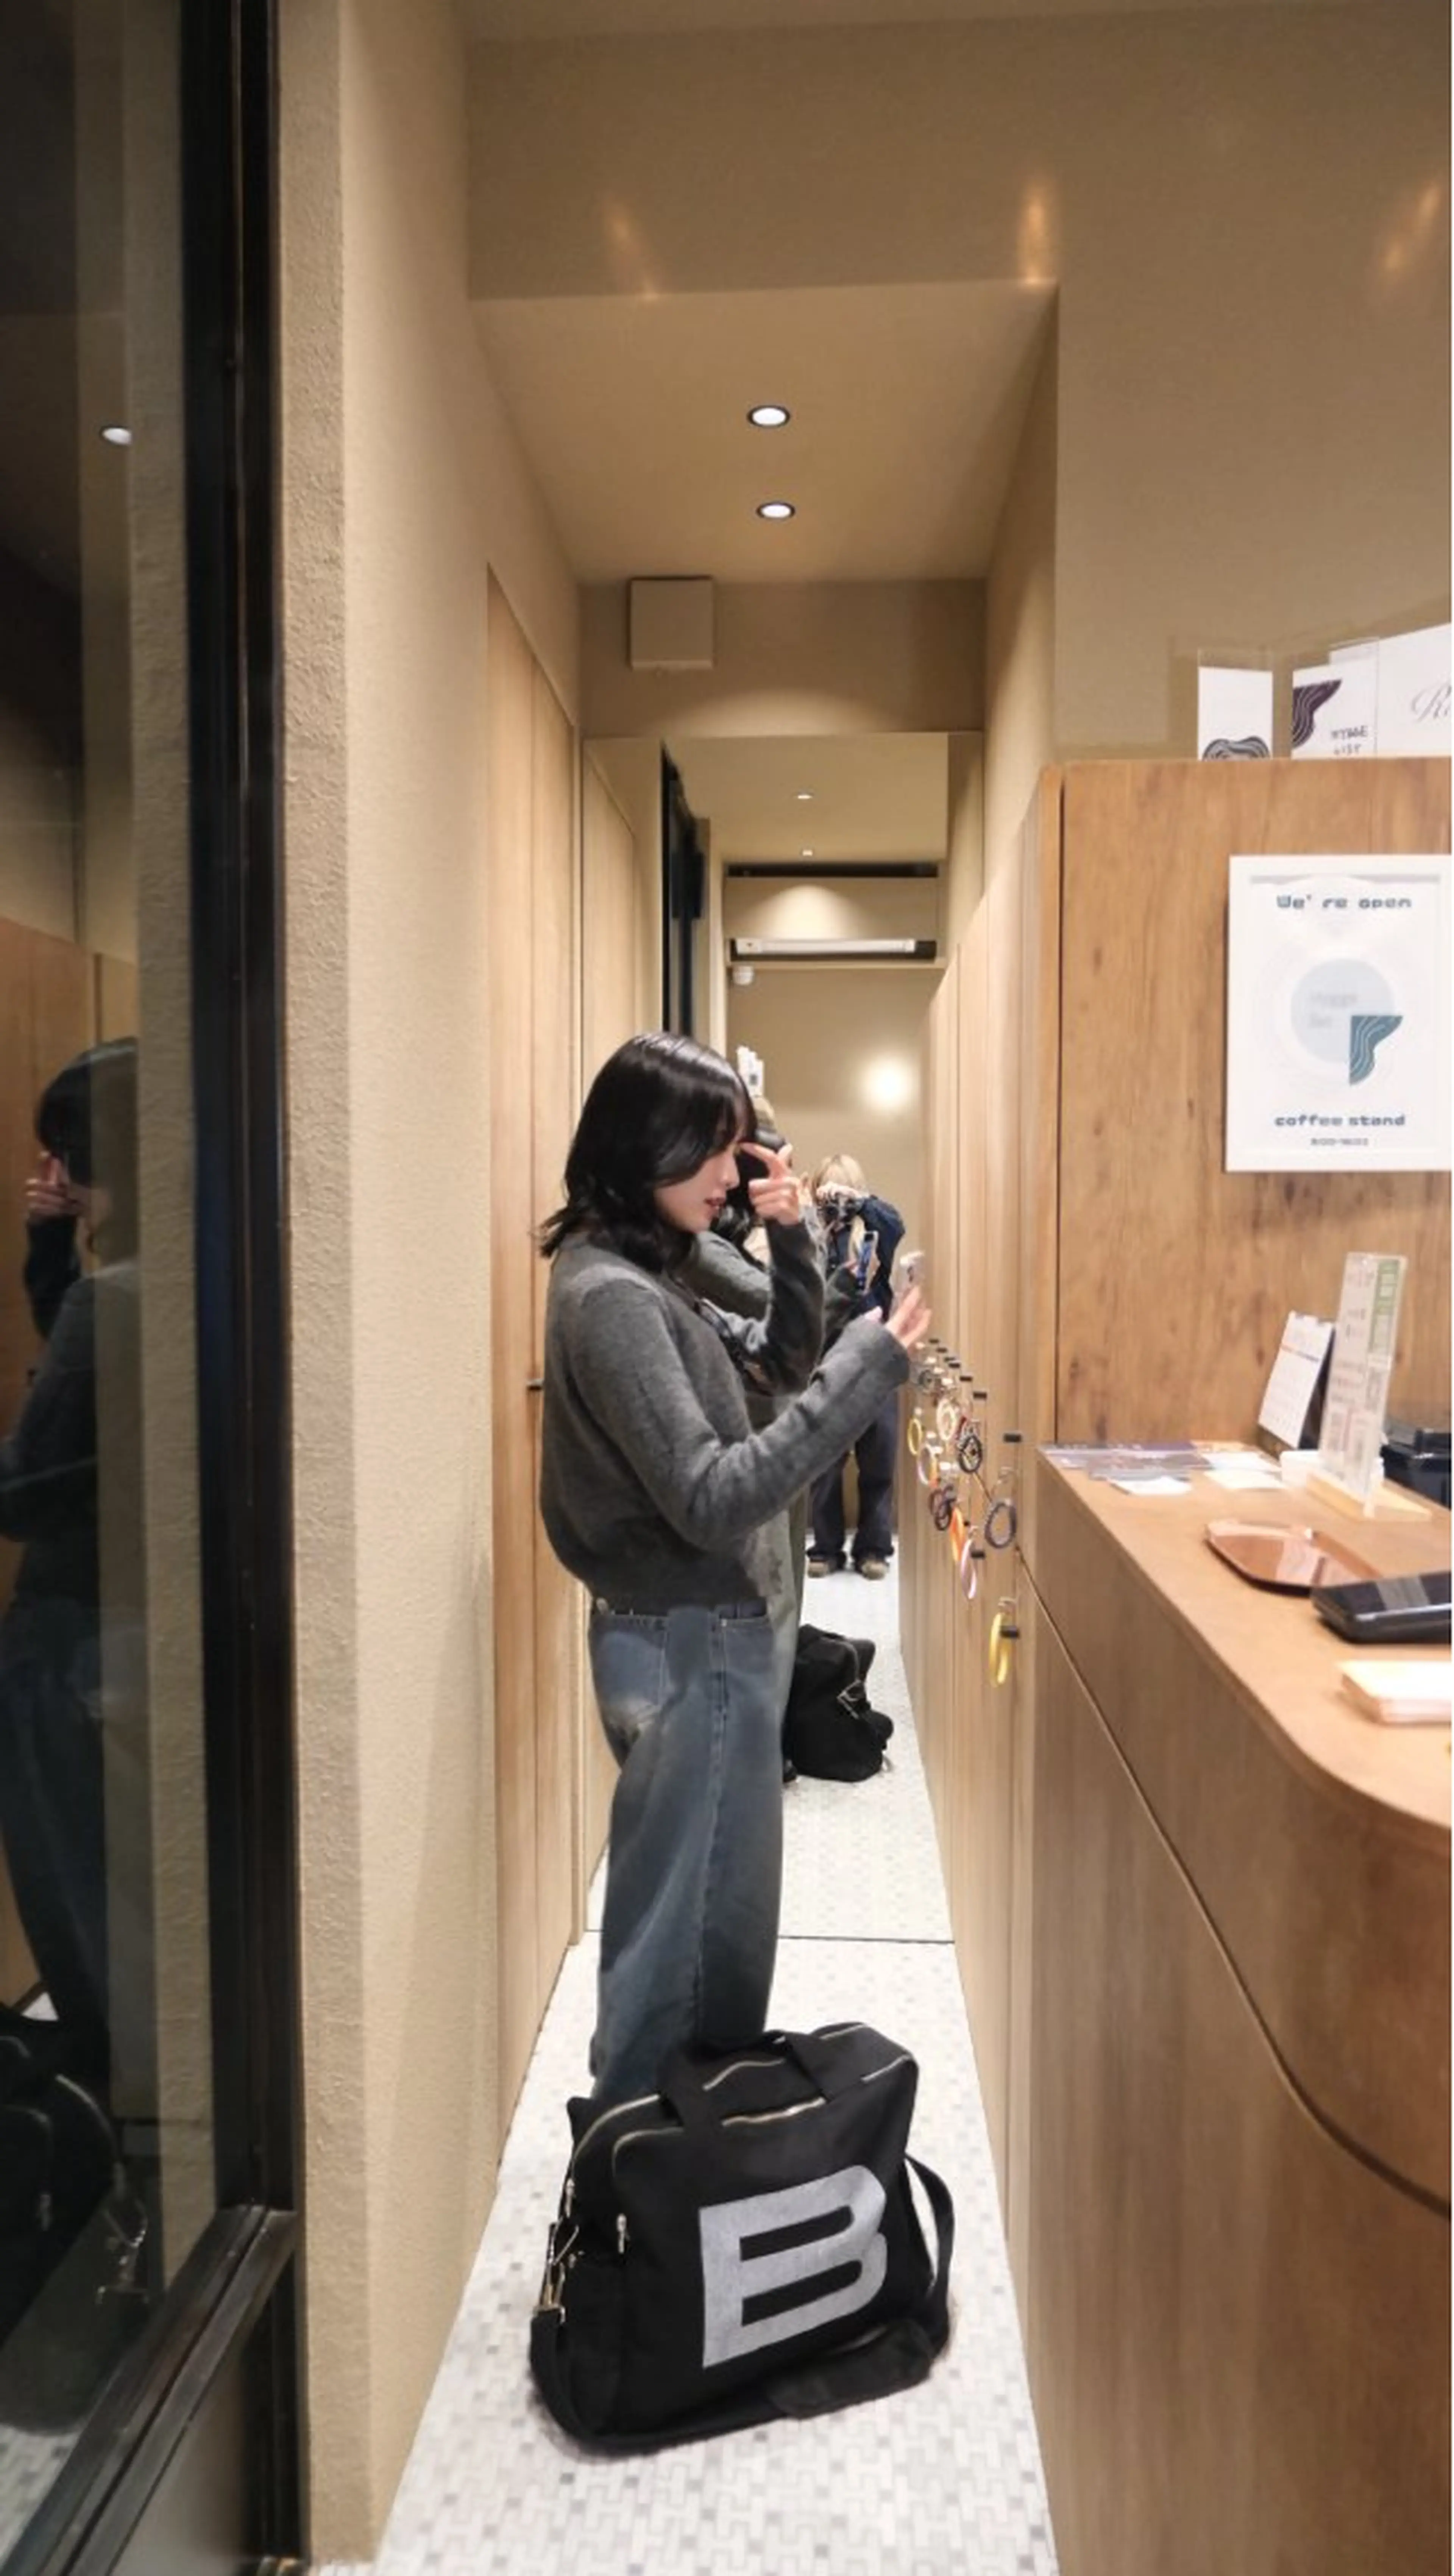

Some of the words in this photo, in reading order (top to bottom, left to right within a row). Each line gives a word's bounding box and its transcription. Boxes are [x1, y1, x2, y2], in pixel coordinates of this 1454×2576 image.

[1358, 898, 1412, 911] open
[1275, 1114, 1343, 1127] coffee
[1349, 1114, 1406, 1127] stand
[699, 2165, 888, 2370] B
